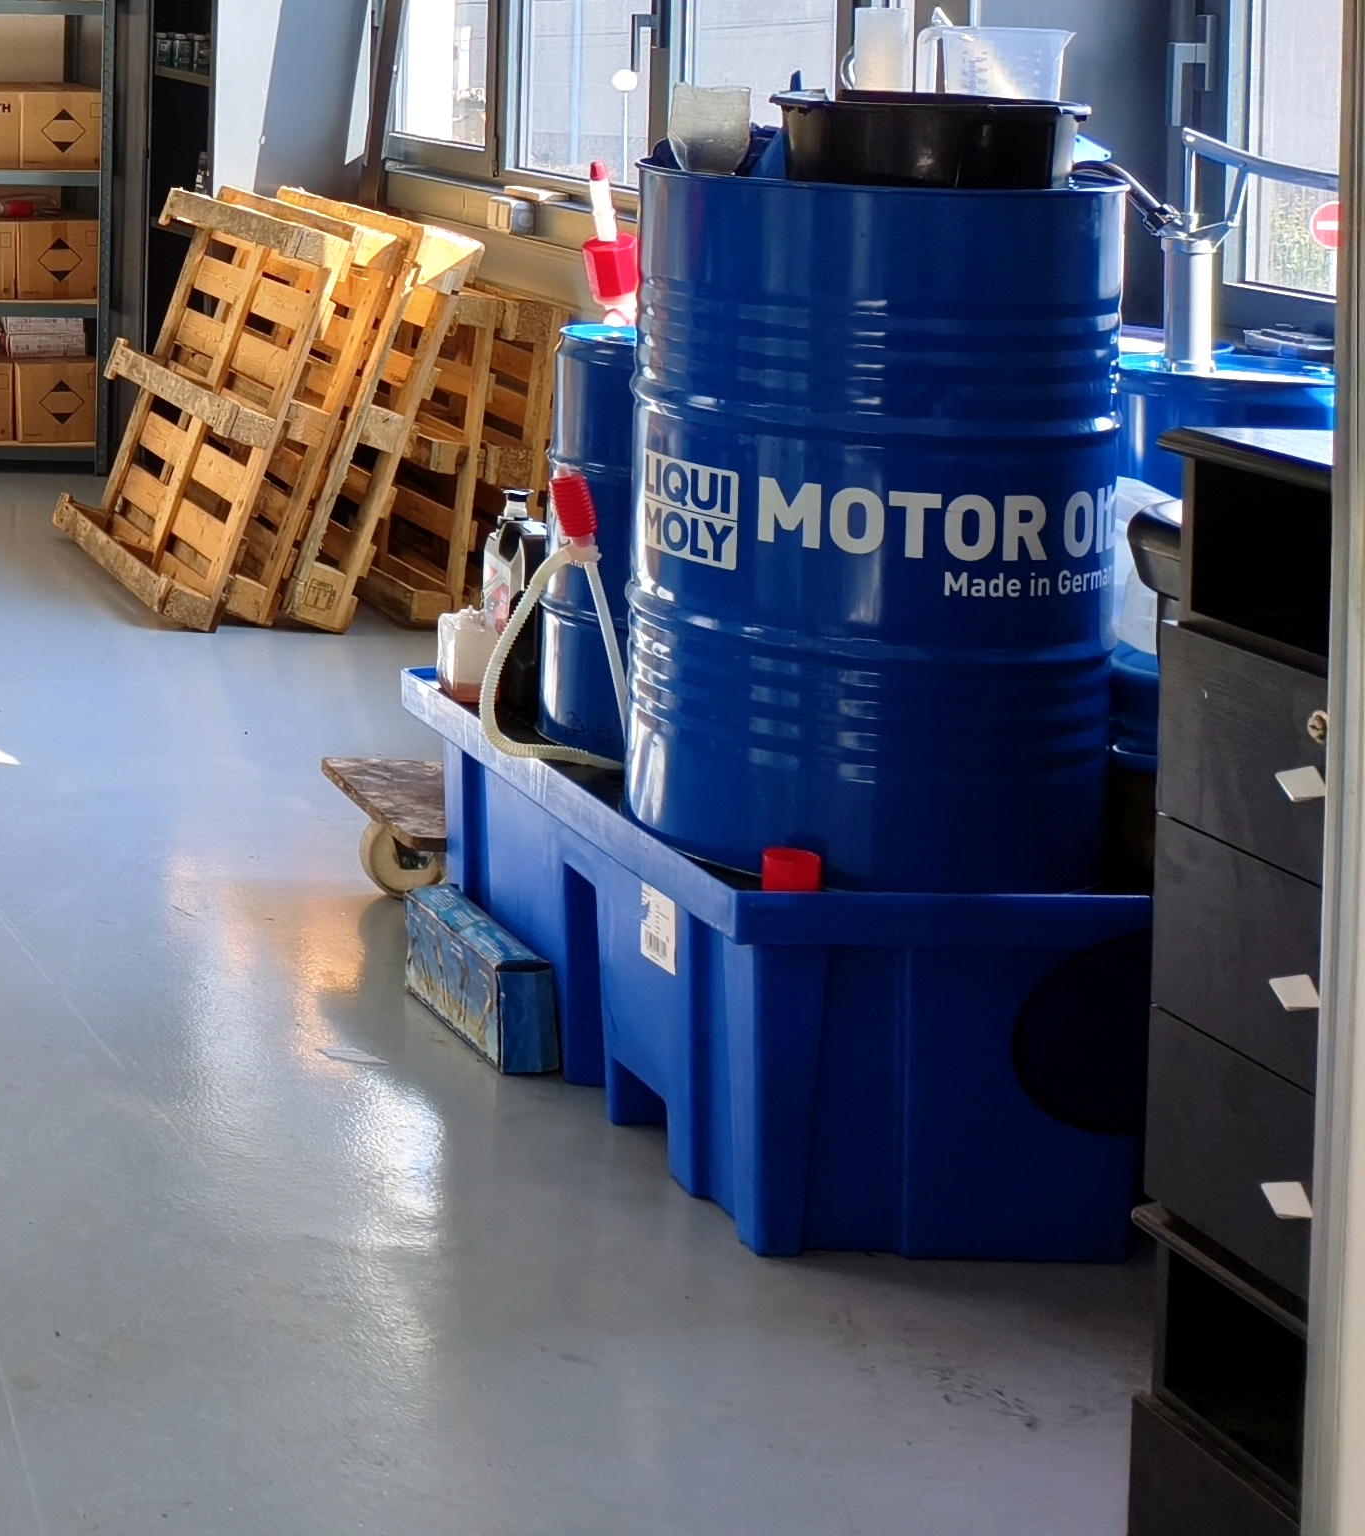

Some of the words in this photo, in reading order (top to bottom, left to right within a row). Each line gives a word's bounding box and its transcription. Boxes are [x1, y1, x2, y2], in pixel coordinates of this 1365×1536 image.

[645, 454, 731, 515] LIQUI
[645, 502, 734, 563] MOLY
[757, 477, 1048, 562] MOTOR
[1064, 484, 1116, 558] OIL
[943, 571, 1021, 597] Made
[1029, 572, 1050, 597] in
